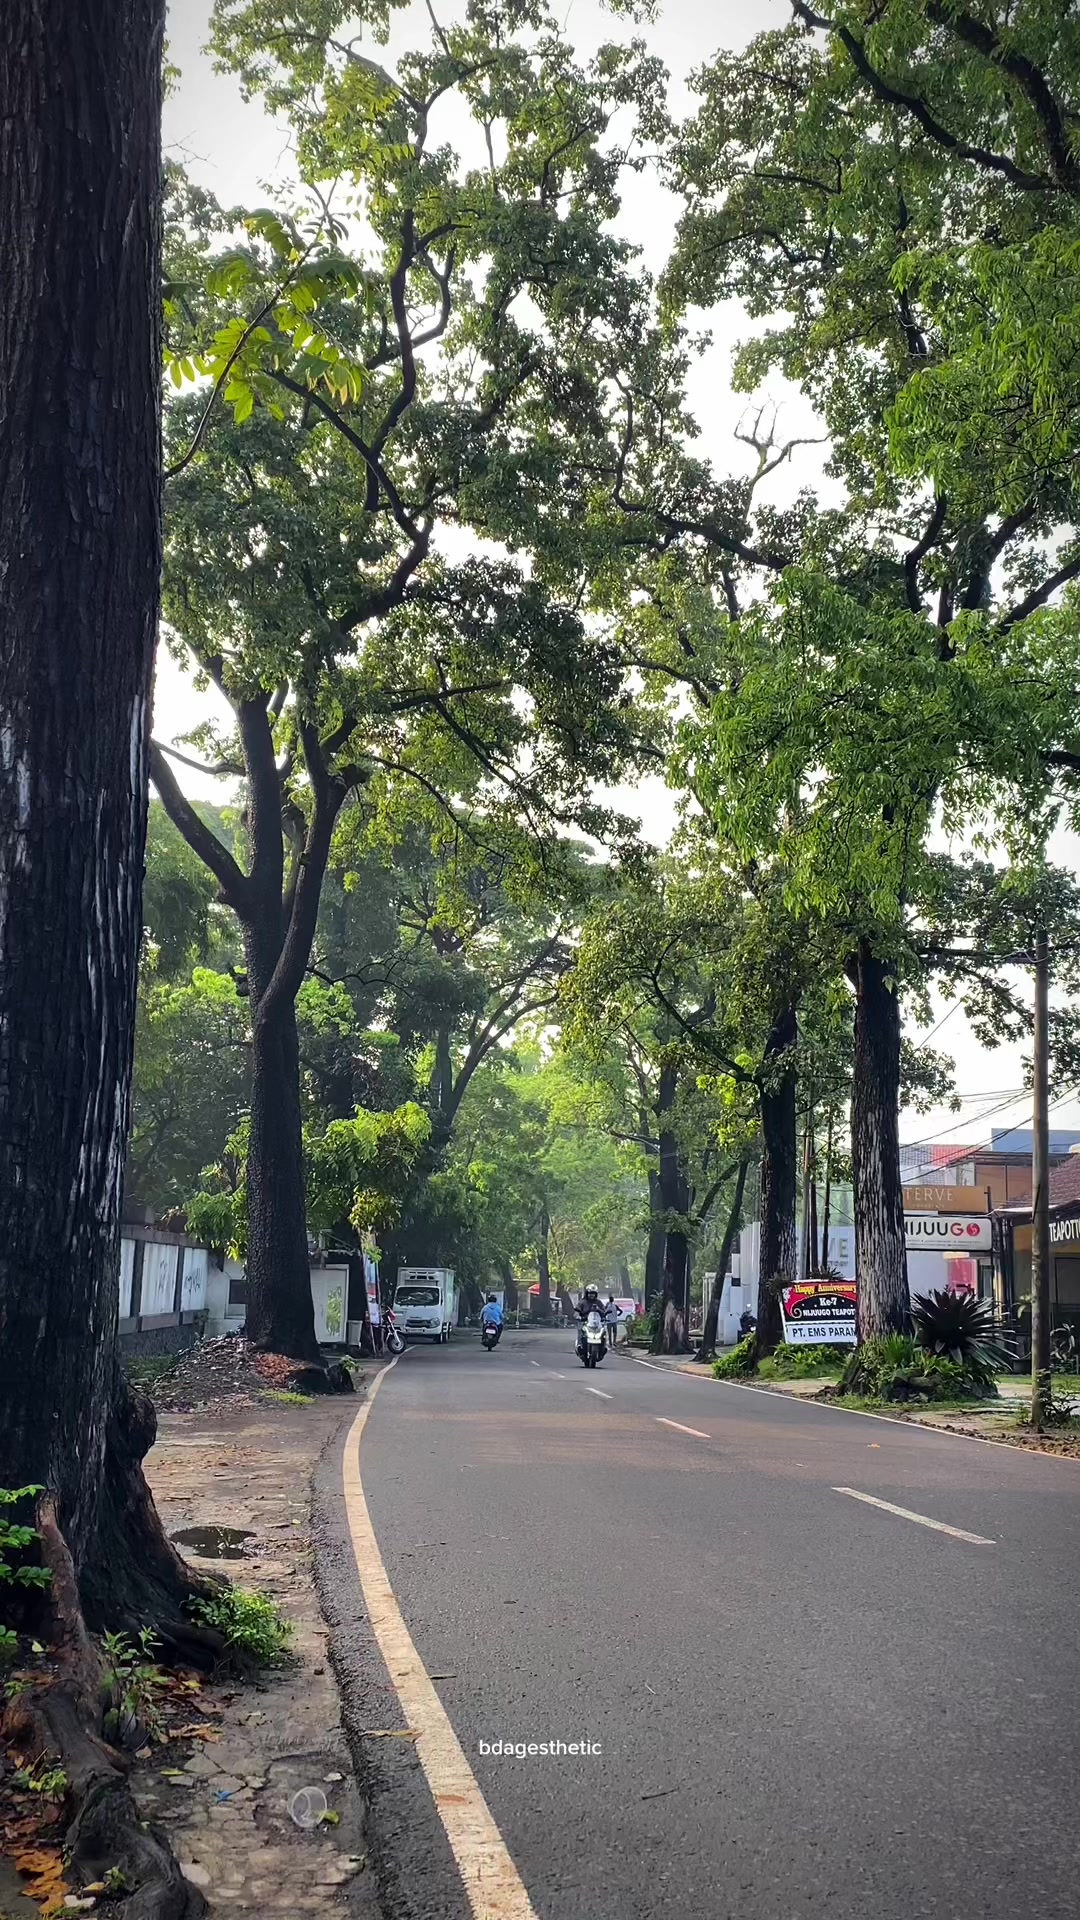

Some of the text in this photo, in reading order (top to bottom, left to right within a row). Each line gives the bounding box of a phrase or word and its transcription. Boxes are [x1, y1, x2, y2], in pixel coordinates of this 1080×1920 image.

[903, 1187, 953, 1201] TERVE
[1049, 1217, 1080, 1242] TEAPOTT
[794, 1283, 856, 1294] Happy Anniversary
[819, 1297, 837, 1306] Ke-7
[803, 1308, 831, 1317] NIJUUGO
[792, 1328, 806, 1337] PT.
[808, 1327, 826, 1337] EMS
